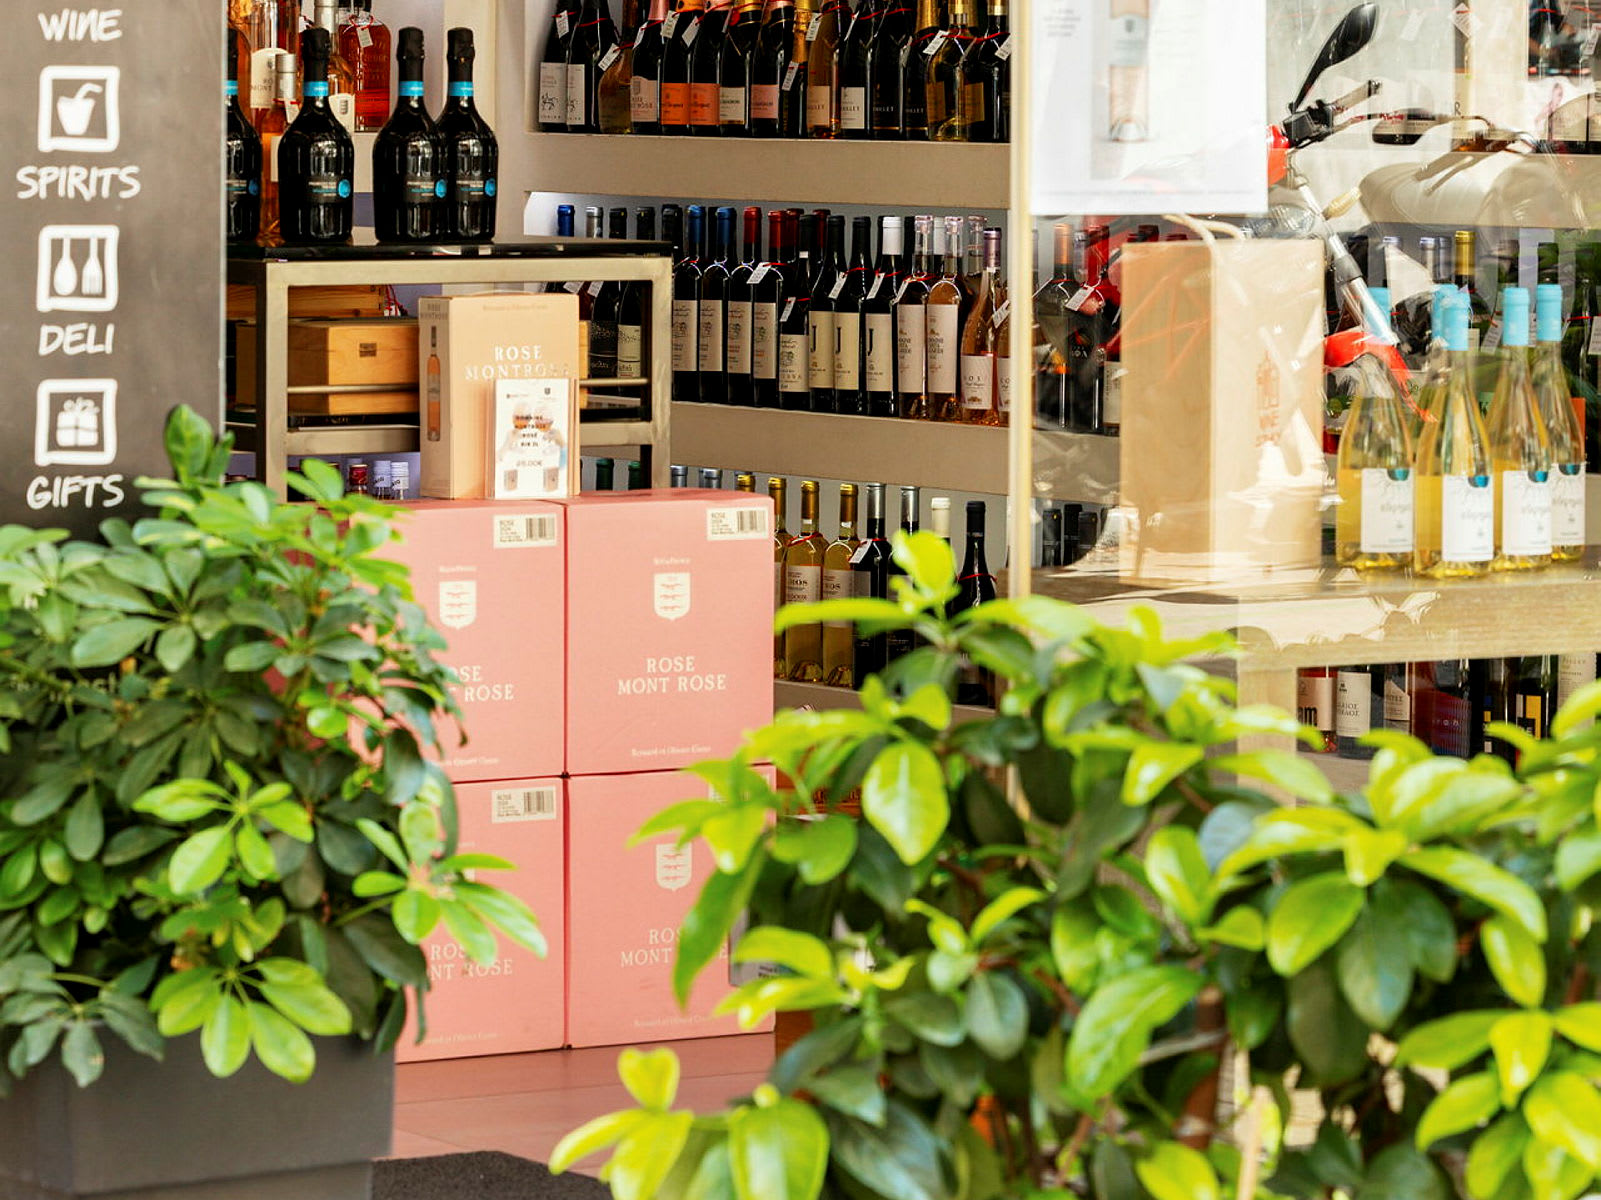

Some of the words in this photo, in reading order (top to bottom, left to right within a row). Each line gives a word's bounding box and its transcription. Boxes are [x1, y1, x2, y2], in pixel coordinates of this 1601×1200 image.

[37, 8, 122, 43] WINE
[15, 165, 141, 201] SPIRITS
[38, 322, 115, 356] DELI
[493, 345, 542, 361] ROSE
[26, 474, 125, 510] GIFTS
[645, 655, 696, 673] ROSE
[463, 683, 515, 703] ROSE
[617, 676, 670, 695] MONT
[677, 673, 727, 692] ROSE
[431, 943, 467, 961] ROS
[620, 947, 672, 968] MONT
[430, 963, 455, 981] NT
